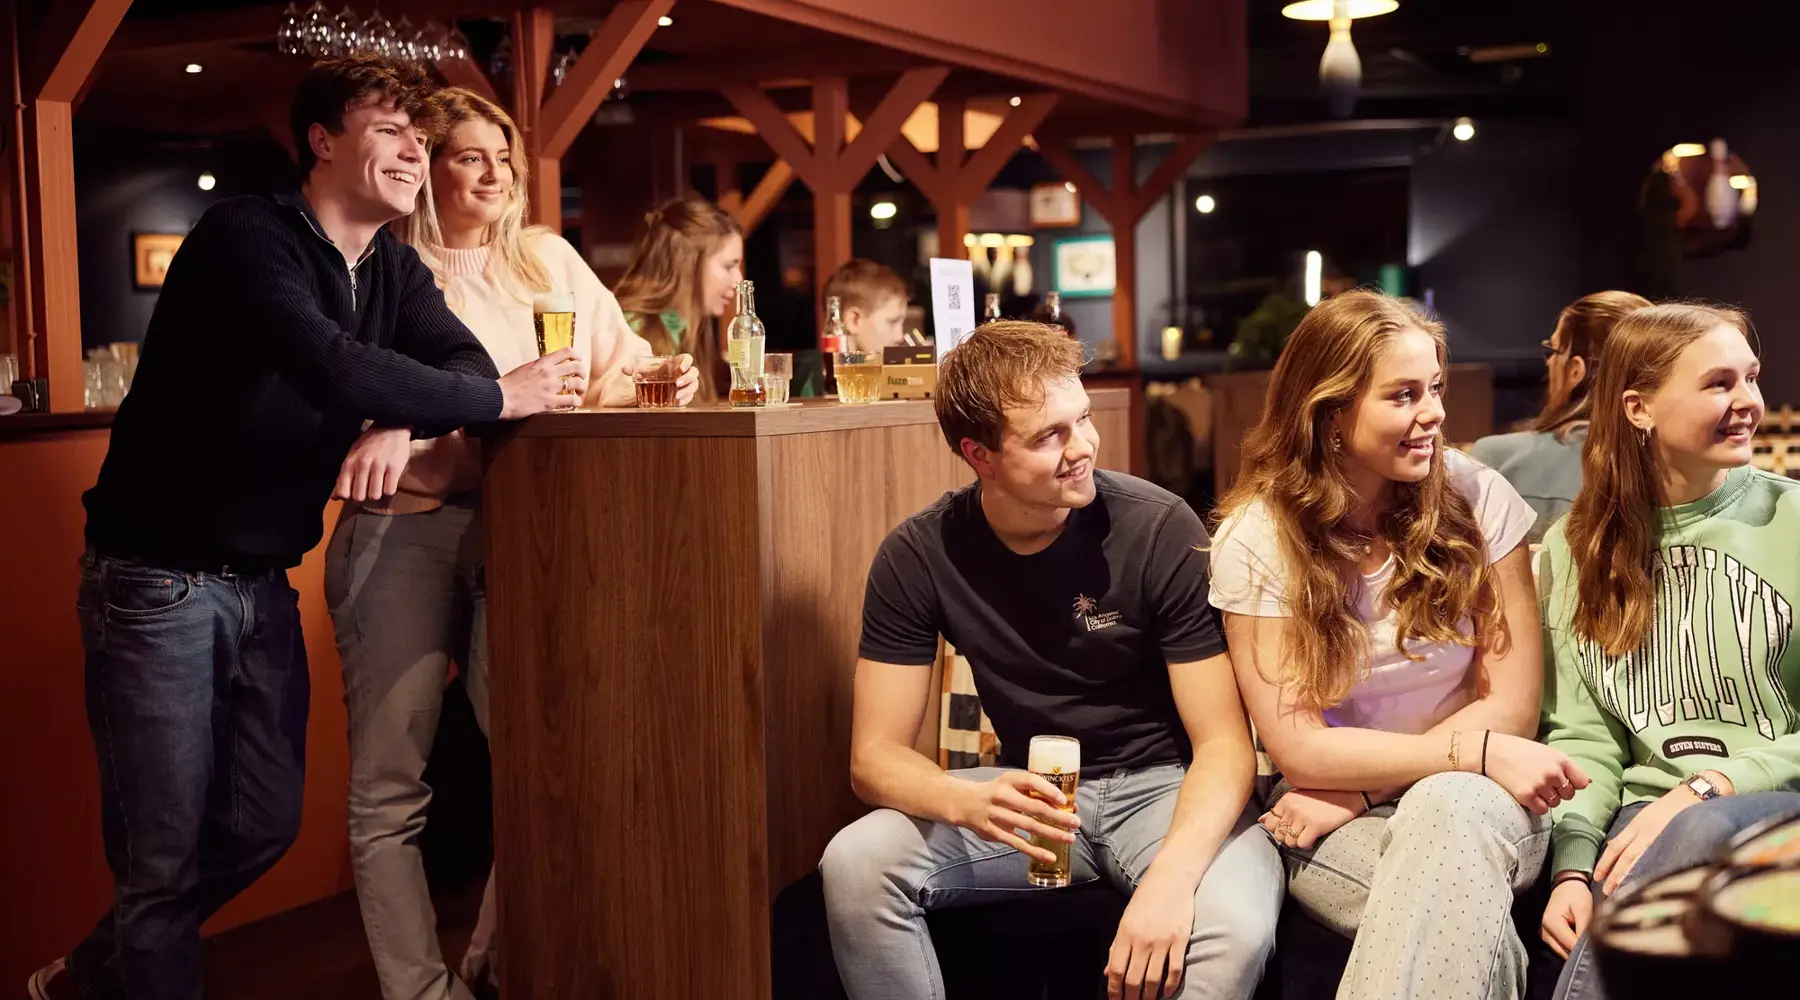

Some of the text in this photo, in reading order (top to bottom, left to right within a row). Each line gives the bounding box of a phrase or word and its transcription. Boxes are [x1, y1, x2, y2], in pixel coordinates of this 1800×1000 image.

[1090, 618, 1100, 626] City
[1669, 741, 1722, 753] SEVEN SISTERS
